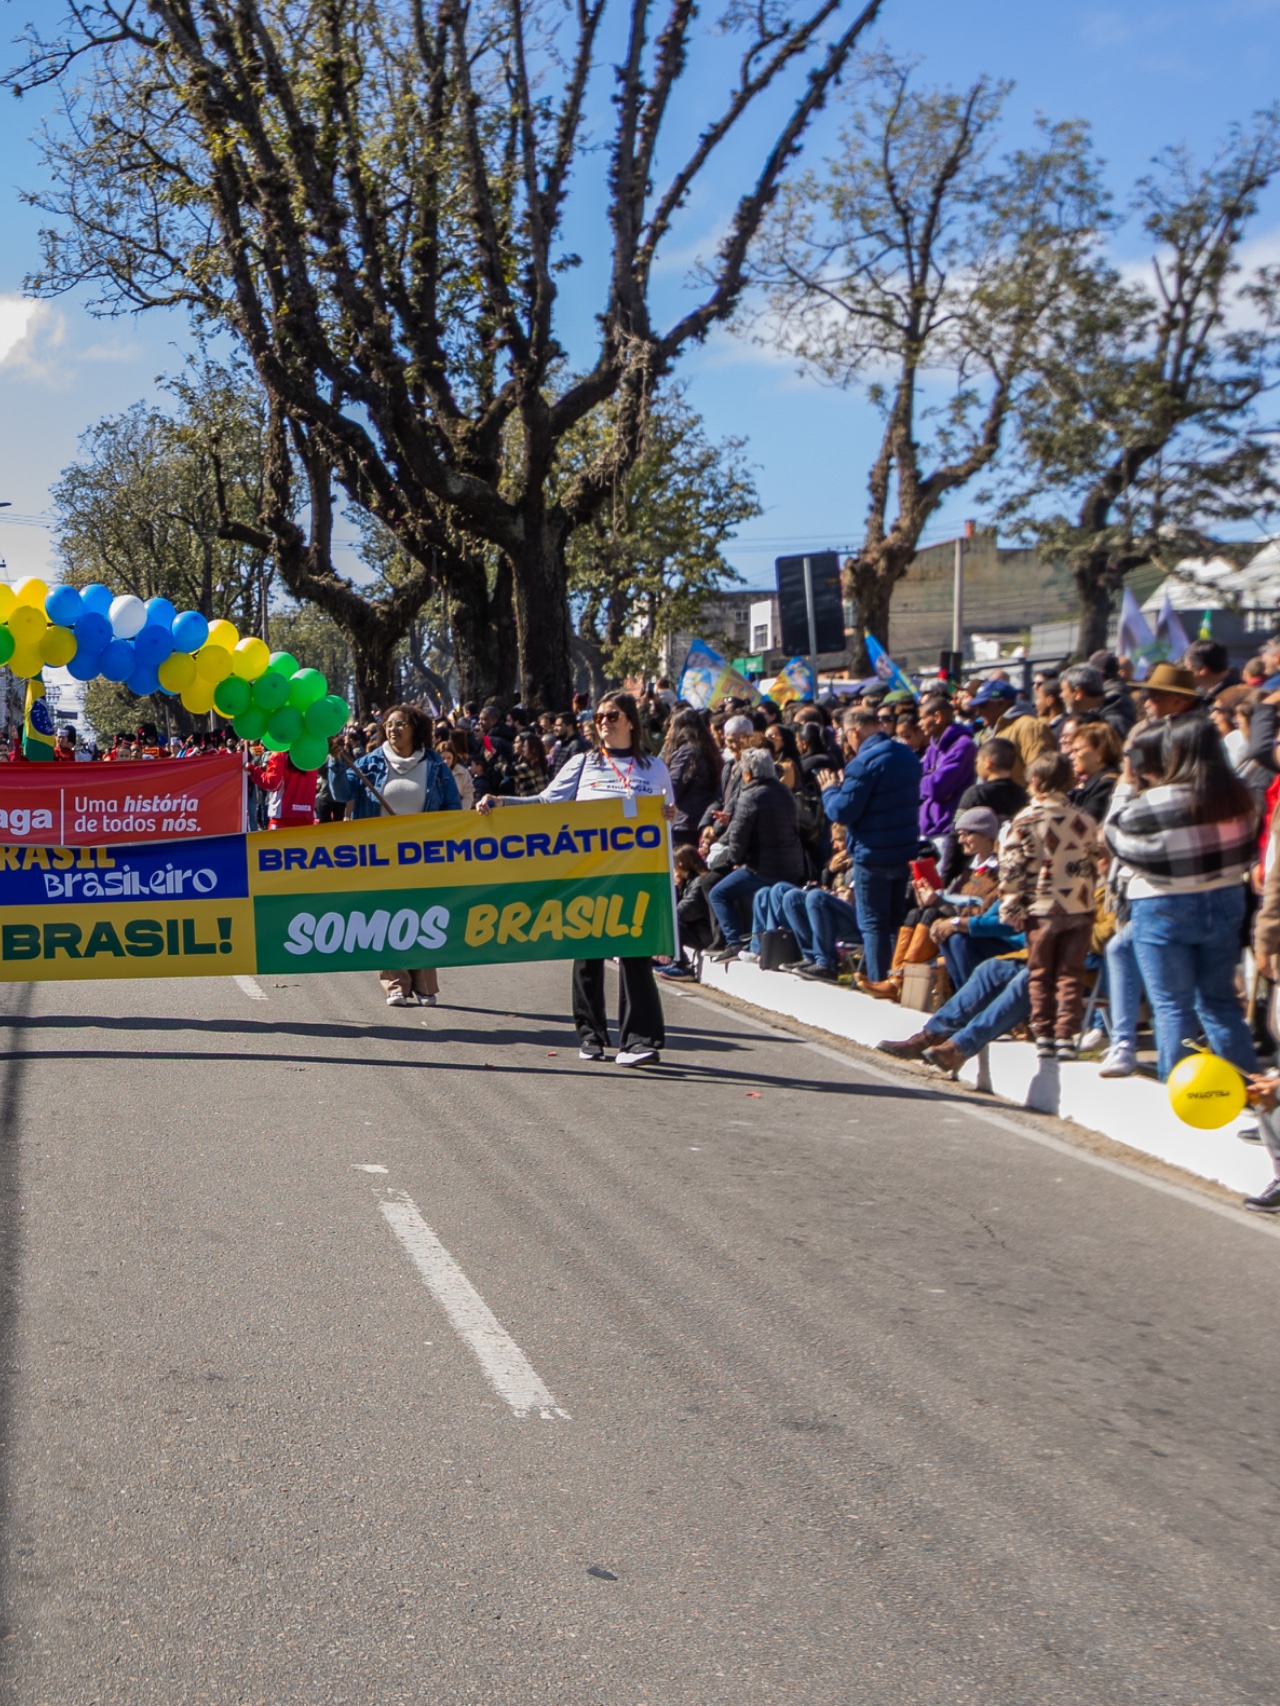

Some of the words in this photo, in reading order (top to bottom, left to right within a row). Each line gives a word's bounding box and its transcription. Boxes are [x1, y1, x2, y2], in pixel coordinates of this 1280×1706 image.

[74, 796, 118, 813] Uma
[123, 794, 199, 813] história
[74, 816, 97, 832] de
[103, 815, 156, 832] todos
[162, 813, 202, 832] nós.
[258, 844, 391, 872] BRASIL
[397, 824, 662, 864] DEMOCRÁTICO
[1, 917, 234, 962] BRASIL!
[284, 905, 450, 955] SOMOS
[464, 891, 650, 948] BRASIL!
